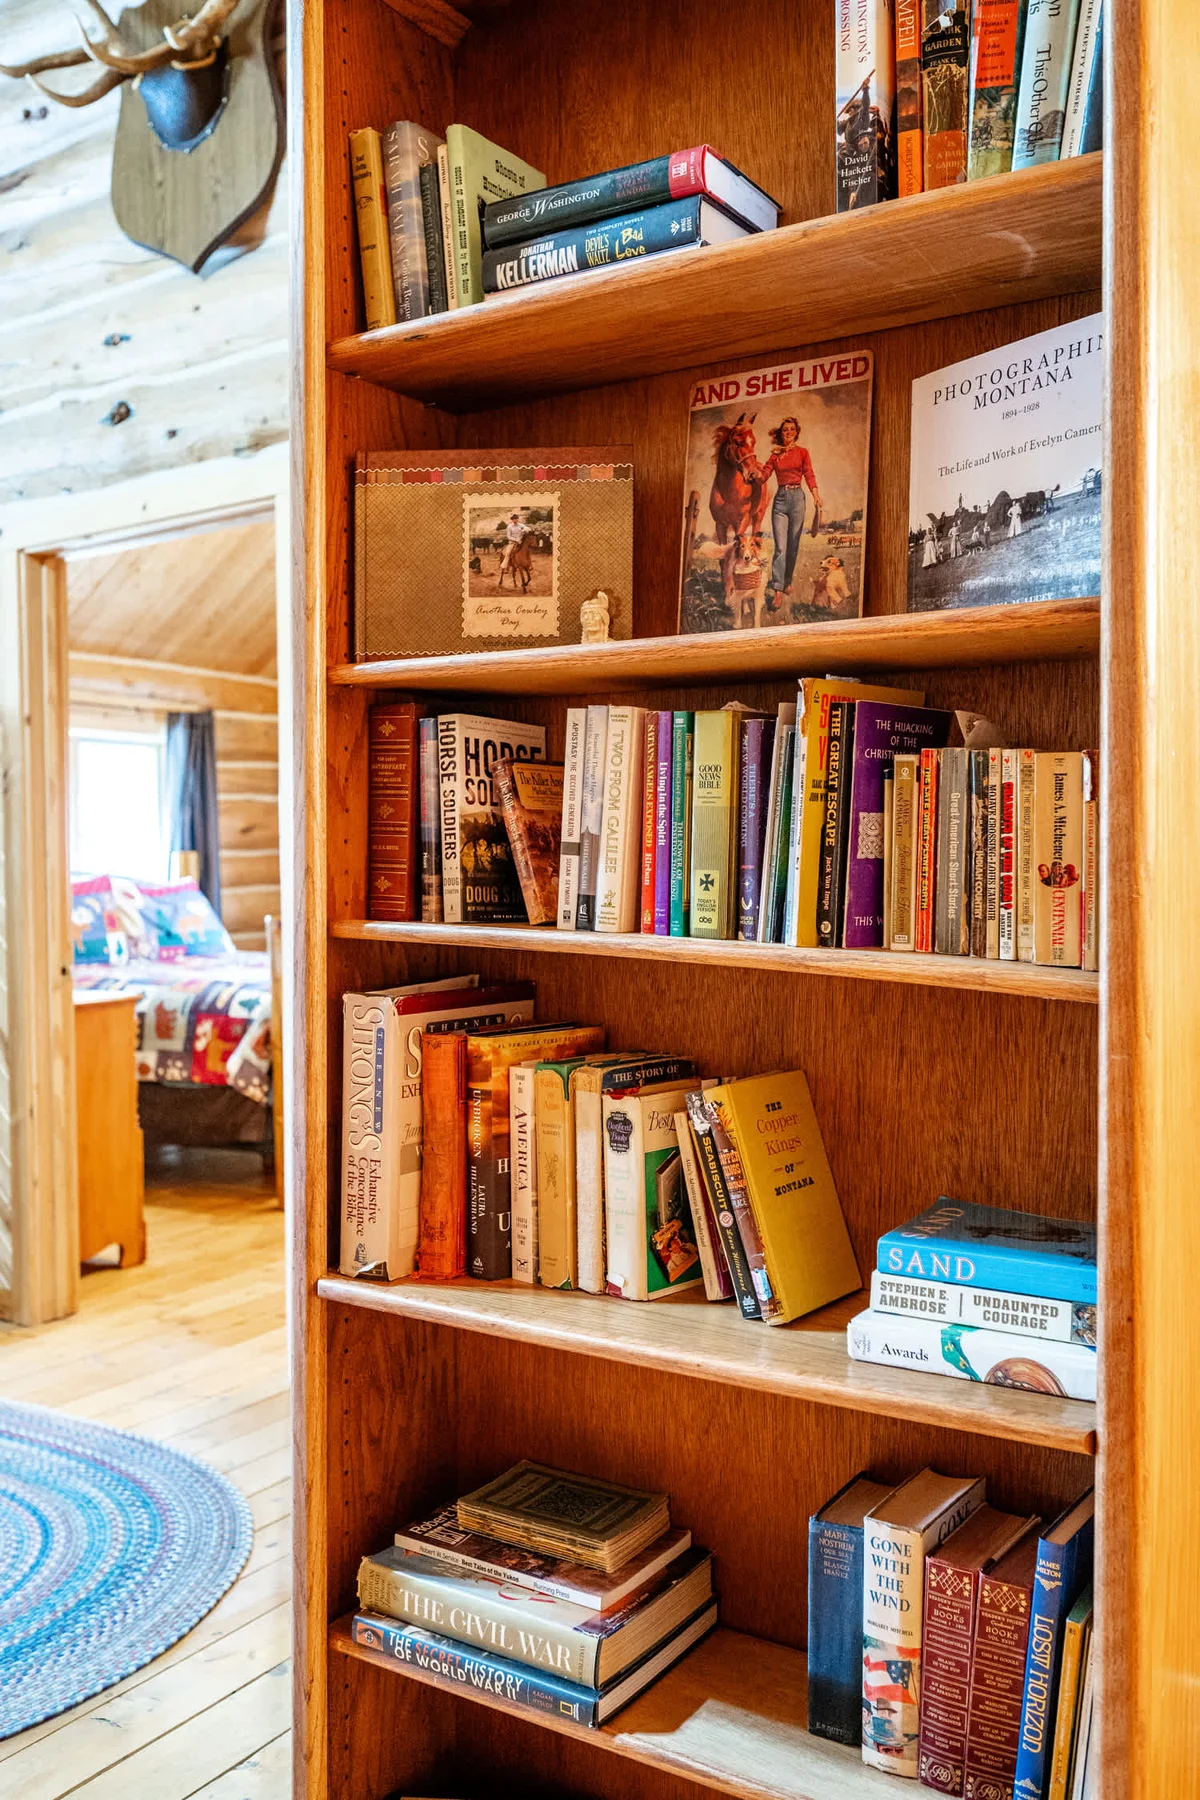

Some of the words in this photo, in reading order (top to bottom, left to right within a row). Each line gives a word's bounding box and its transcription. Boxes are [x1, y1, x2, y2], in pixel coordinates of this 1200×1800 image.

[1086, 0, 1094, 21] THE
[925, 38, 962, 52] GARDEN
[1080, 26, 1091, 68] PRETTY
[1034, 44, 1052, 77] This
[1030, 78, 1048, 121] Other
[1072, 72, 1084, 114] HORSES
[841, 164, 872, 178] Hackett
[844, 154, 868, 165] David
[842, 176, 871, 188] Fischer
[497, 207, 531, 224] GEORGE
[524, 189, 600, 222] WASHINGTON
[586, 228, 597, 236] TWO
[598, 222, 624, 233] COMPLETE
[622, 228, 644, 246] Bad
[520, 240, 554, 259] JONATHAN
[585, 233, 610, 251] DEVIL'S
[496, 244, 579, 290] KELLERMAN
[586, 249, 611, 268] WALTZ
[402, 258, 411, 288] Going
[692, 380, 741, 408] AND
[746, 370, 793, 397] SHE
[798, 356, 870, 388] LIVED
[973, 365, 1073, 410] MONTANA
[938, 466, 955, 478] The
[956, 458, 973, 473] Life
[974, 454, 991, 467] and
[991, 445, 1016, 461] Work
[1018, 442, 1029, 455] of
[1030, 432, 1063, 451] Evelyn
[475, 604, 512, 615] Another
[516, 604, 549, 619] Cowboy
[831, 708, 842, 737] THE
[876, 719, 891, 730] THE
[895, 722, 934, 735] HIJACKING
[439, 720, 457, 784] HORSE
[570, 722, 579, 759] APOSTASY
[611, 730, 625, 767] TWO
[890, 736, 900, 746] OF
[903, 737, 917, 748] THE
[658, 762, 668, 789] Living
[698, 764, 722, 774] GOOD
[700, 772, 721, 781] NEWS
[828, 741, 840, 788] GREAT
[532, 772, 549, 787] Killer
[568, 774, 577, 801] DECEIVED
[608, 770, 622, 810] FROM
[646, 761, 656, 799] ANGELS
[699, 780, 722, 789] BIBLE
[749, 764, 757, 808] THERE'S
[1054, 773, 1067, 803] James
[659, 802, 667, 816] the
[950, 792, 961, 813] Great
[989, 785, 997, 814] MOJAVE
[1054, 803, 1066, 814] A.
[442, 790, 457, 860] SOLDIERS
[566, 804, 576, 837] GENERATION
[645, 801, 655, 848] EXPOSED
[741, 802, 749, 848] COMING
[826, 792, 838, 847] ESCAPE
[605, 815, 620, 873] GALILEE
[657, 819, 667, 846] Spirit
[949, 816, 960, 859] American
[989, 816, 997, 857] CROSSING
[1002, 836, 1014, 849] OF
[1053, 815, 1067, 862] Michener
[564, 858, 572, 877] SUSAN
[824, 857, 833, 874] Jack
[948, 862, 959, 886] Short
[975, 850, 983, 879] INDIAN
[988, 862, 996, 884] LOUIS
[824, 874, 832, 889] Van
[466, 886, 499, 903] DOUG
[823, 891, 831, 910] Impe
[948, 888, 958, 919] Stories
[974, 881, 983, 920] COUNTRY
[987, 886, 996, 922] L'AMOUR
[854, 917, 873, 927] THIS
[1052, 888, 1066, 947] CENTENNIAL
[430, 1021, 460, 1034] THE
[473, 1016, 503, 1028] NEW
[350, 1004, 384, 1152] STRONG'S
[613, 1071, 633, 1083] THE
[636, 1067, 663, 1081] STORY
[666, 1064, 679, 1076] OF
[765, 1102, 783, 1113] THE
[473, 1090, 482, 1159] UNBROKEN
[757, 1113, 799, 1134] Copper
[514, 1104, 529, 1193] AMERICA
[764, 1136, 802, 1156] Kings
[348, 1154, 355, 1170] of
[702, 1136, 728, 1210] SEABISCUIT
[784, 1164, 795, 1174] OF
[347, 1172, 355, 1189] the
[368, 1159, 382, 1224] Exhaustive
[774, 1176, 815, 1197] MONTANA
[346, 1191, 354, 1223] Bible
[356, 1156, 369, 1237] Concordance
[470, 1166, 478, 1235] HILLENBRAND
[478, 1185, 486, 1217] LAURA
[902, 1207, 965, 1240] SAND
[888, 1248, 976, 1282] SAND
[880, 1281, 935, 1299] STEPHEN
[939, 1290, 949, 1301] E.
[879, 1294, 947, 1316] AMBROSE
[973, 1295, 1060, 1318] UNDAUNTED
[983, 1311, 1048, 1331] COURAGE
[881, 1343, 930, 1362] Awards
[410, 1510, 451, 1534] Robert
[818, 1538, 855, 1552] NOSTRUM
[824, 1530, 848, 1541] MARE
[870, 1536, 912, 1558] GONE
[462, 1558, 473, 1568] Best
[473, 1562, 487, 1573] Tales
[487, 1567, 494, 1575] of
[494, 1569, 503, 1578] the
[503, 1572, 520, 1583] Yukon
[824, 1560, 850, 1572] BLASCO
[871, 1554, 910, 1576] WITH
[1039, 1558, 1061, 1570] JAMES
[533, 1582, 555, 1595] Running
[556, 1588, 570, 1600] Press
[877, 1574, 904, 1594] THE
[870, 1590, 911, 1613] WIND
[868, 1620, 889, 1631] MARGARET
[890, 1627, 914, 1637] MITCHELL
[933, 1609, 965, 1624] BOOKS
[400, 1589, 444, 1626] THE
[450, 1608, 514, 1651] CIVIL
[518, 1631, 572, 1673] WAR
[985, 1626, 1019, 1640] BOOKS
[1031, 1613, 1054, 1667] LOST
[389, 1632, 412, 1649] THE
[415, 1642, 461, 1669] SECRET
[465, 1659, 524, 1692] HISTORY
[394, 1647, 412, 1663] OF
[416, 1653, 466, 1682] WORLD
[470, 1672, 503, 1696] WAR
[1022, 1668, 1049, 1754] HORIZON
